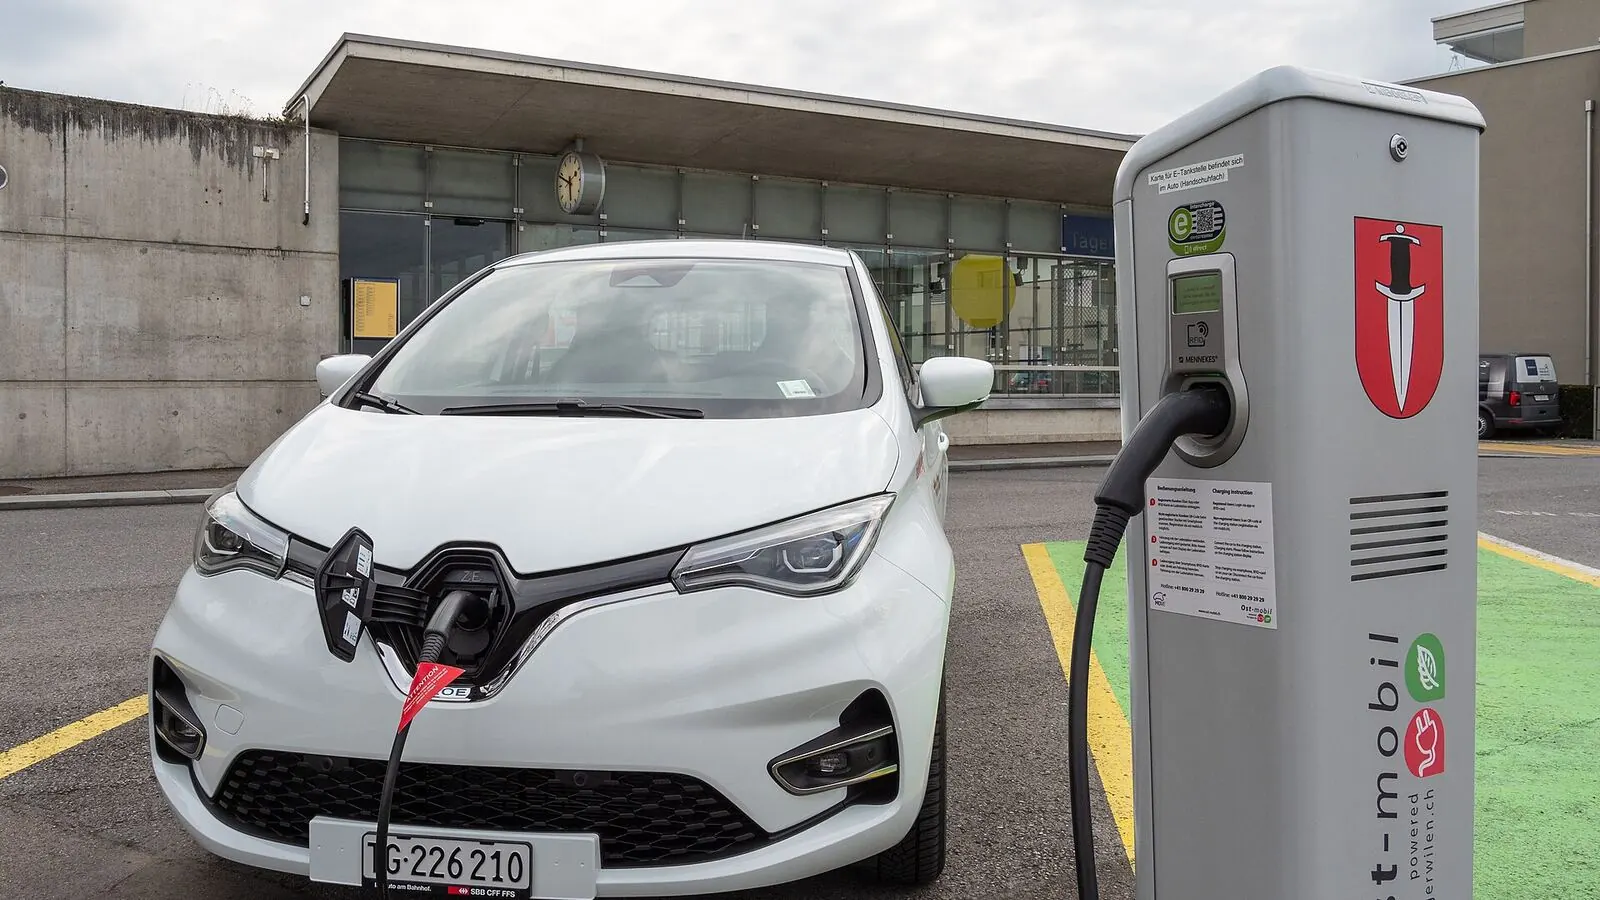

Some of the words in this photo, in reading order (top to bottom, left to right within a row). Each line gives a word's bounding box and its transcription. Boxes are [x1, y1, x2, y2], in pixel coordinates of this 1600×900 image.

[1150, 173, 1164, 182] Karte
[1208, 159, 1231, 171] befindet
[1231, 156, 1243, 166] sich
[1159, 184, 1166, 192] im
[1167, 182, 1179, 190] Auto
[1240, 604, 1273, 615] Ost-mobil
[1408, 793, 1420, 880] powered
[1423, 788, 1435, 900] erwilen.ch
[470, 888, 485, 896] SBB
[486, 889, 501, 897] CFF
[501, 890, 516, 898] FFS
